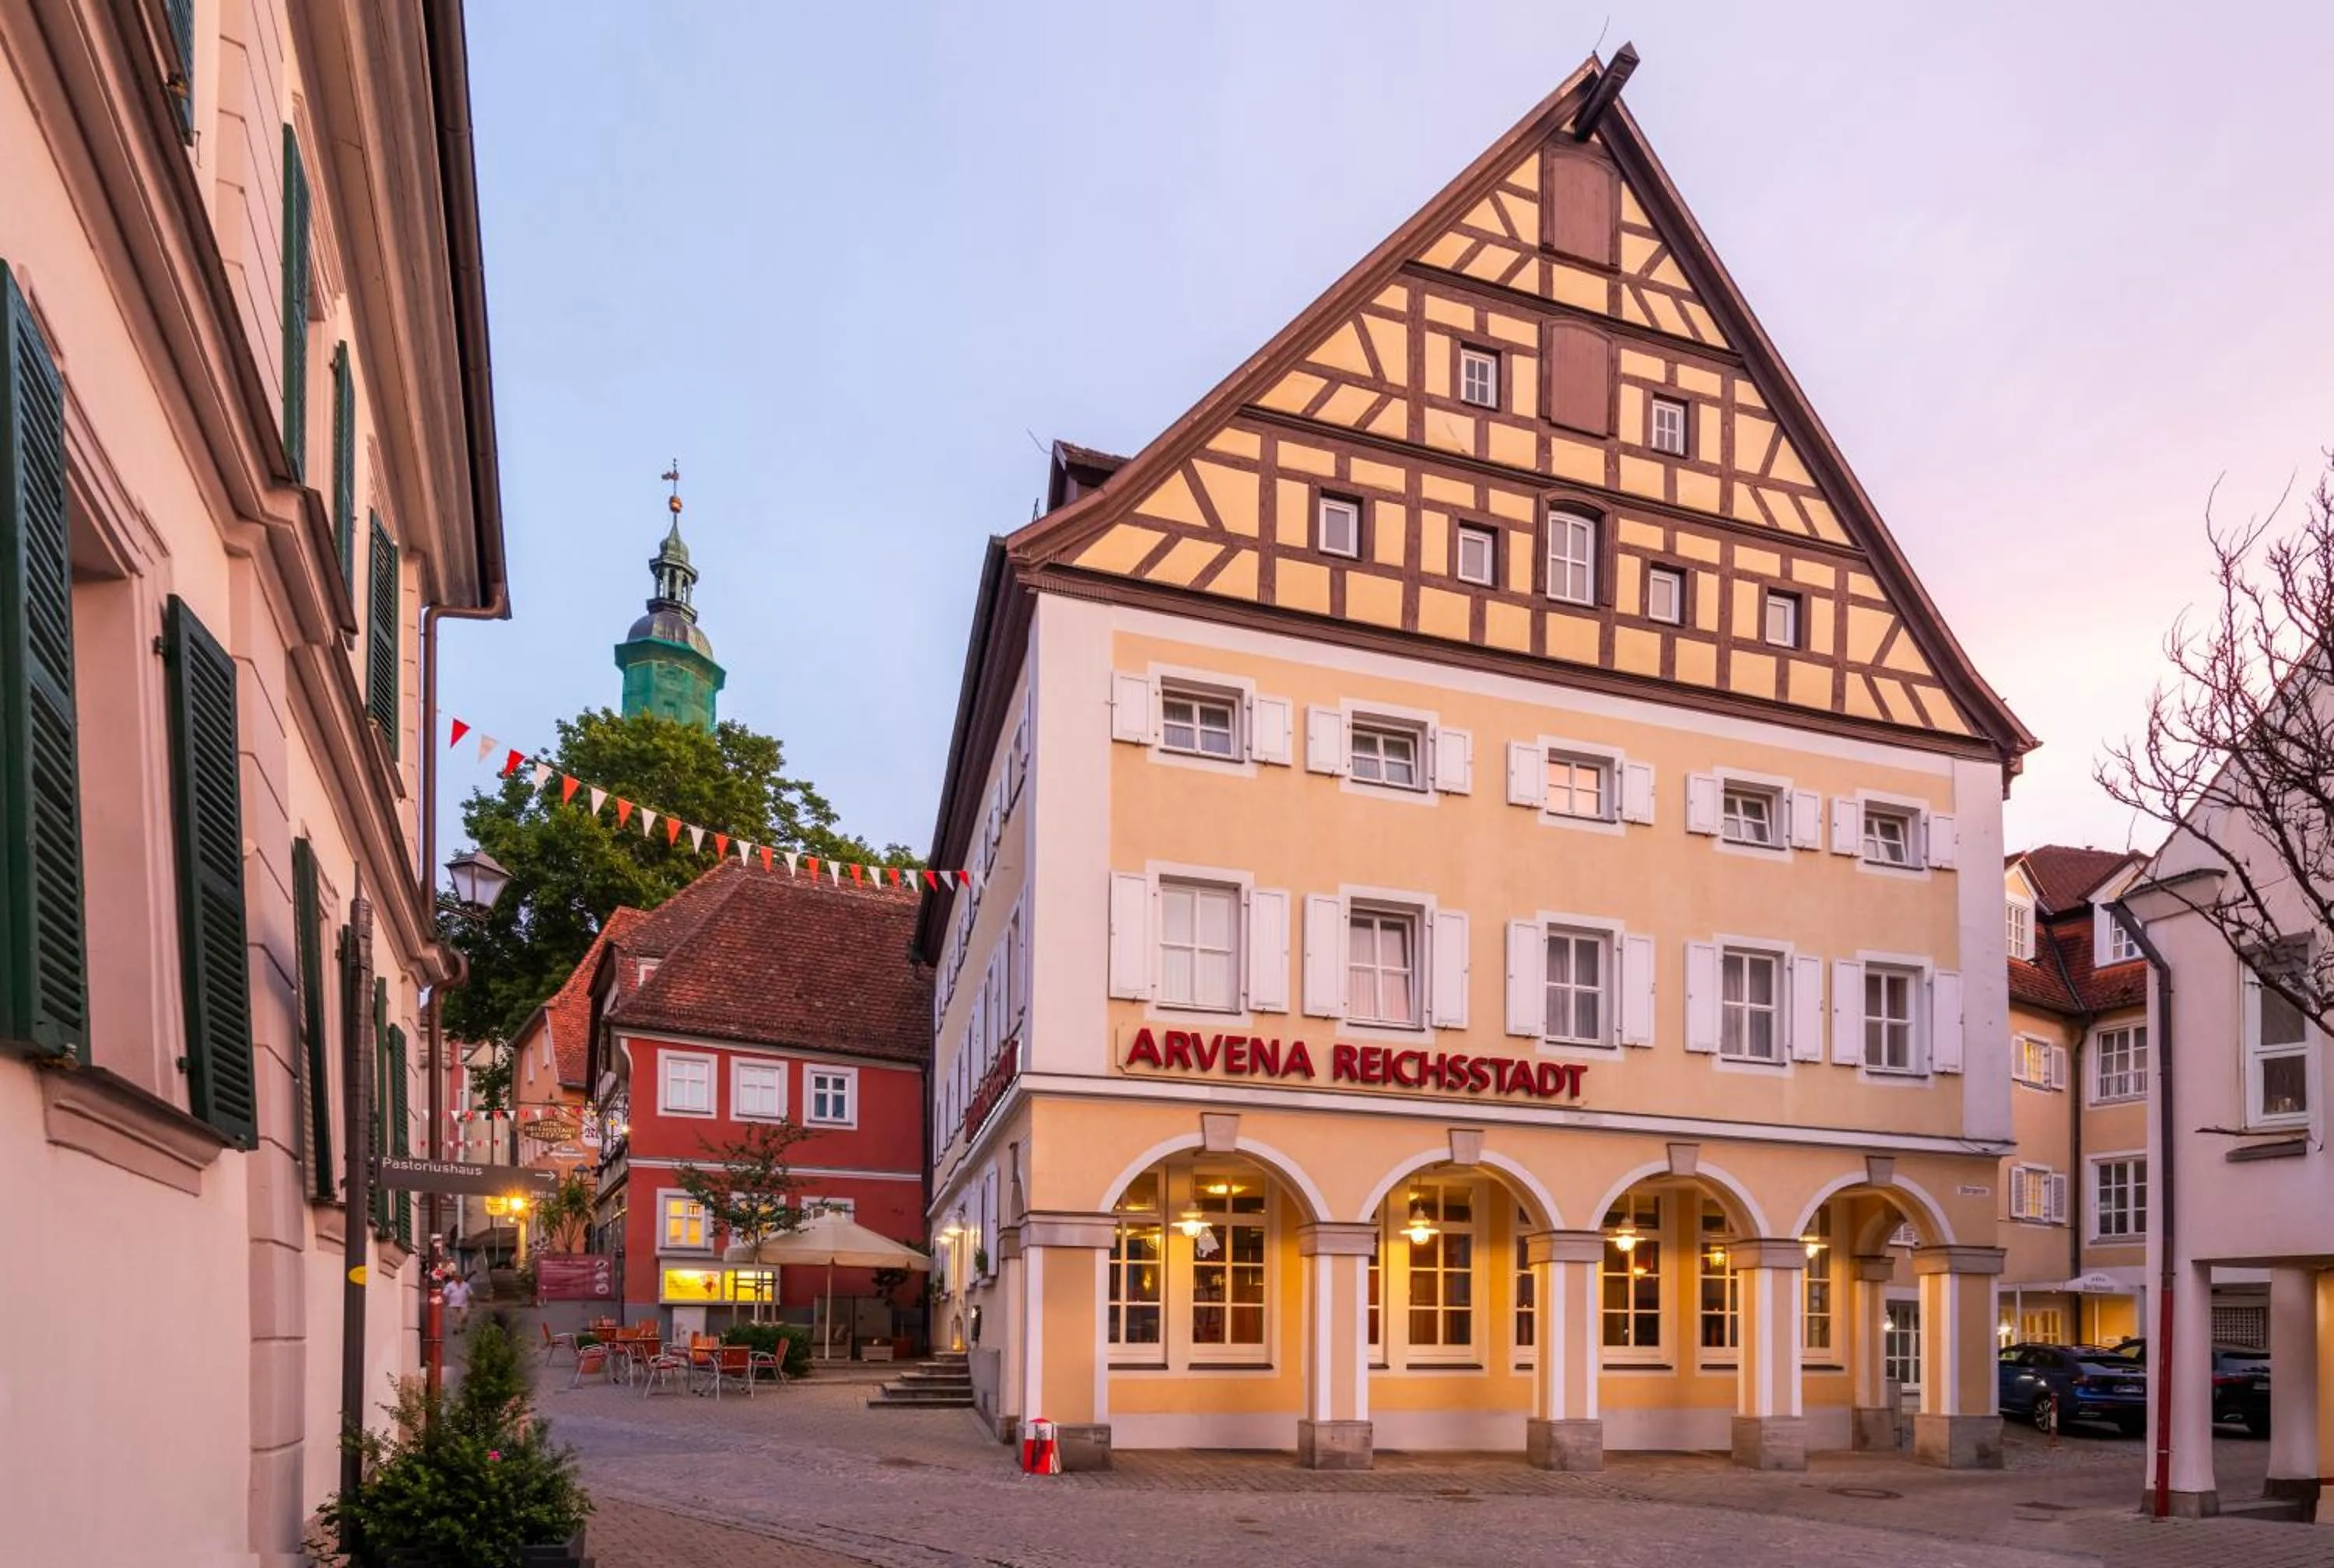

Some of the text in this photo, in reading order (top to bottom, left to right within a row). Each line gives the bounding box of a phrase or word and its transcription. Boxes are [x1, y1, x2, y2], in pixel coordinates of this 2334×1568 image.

[1126, 1027, 1588, 1099] ARVENA REICHSSTADT
[382, 1157, 483, 1176] Pastoriushaus
